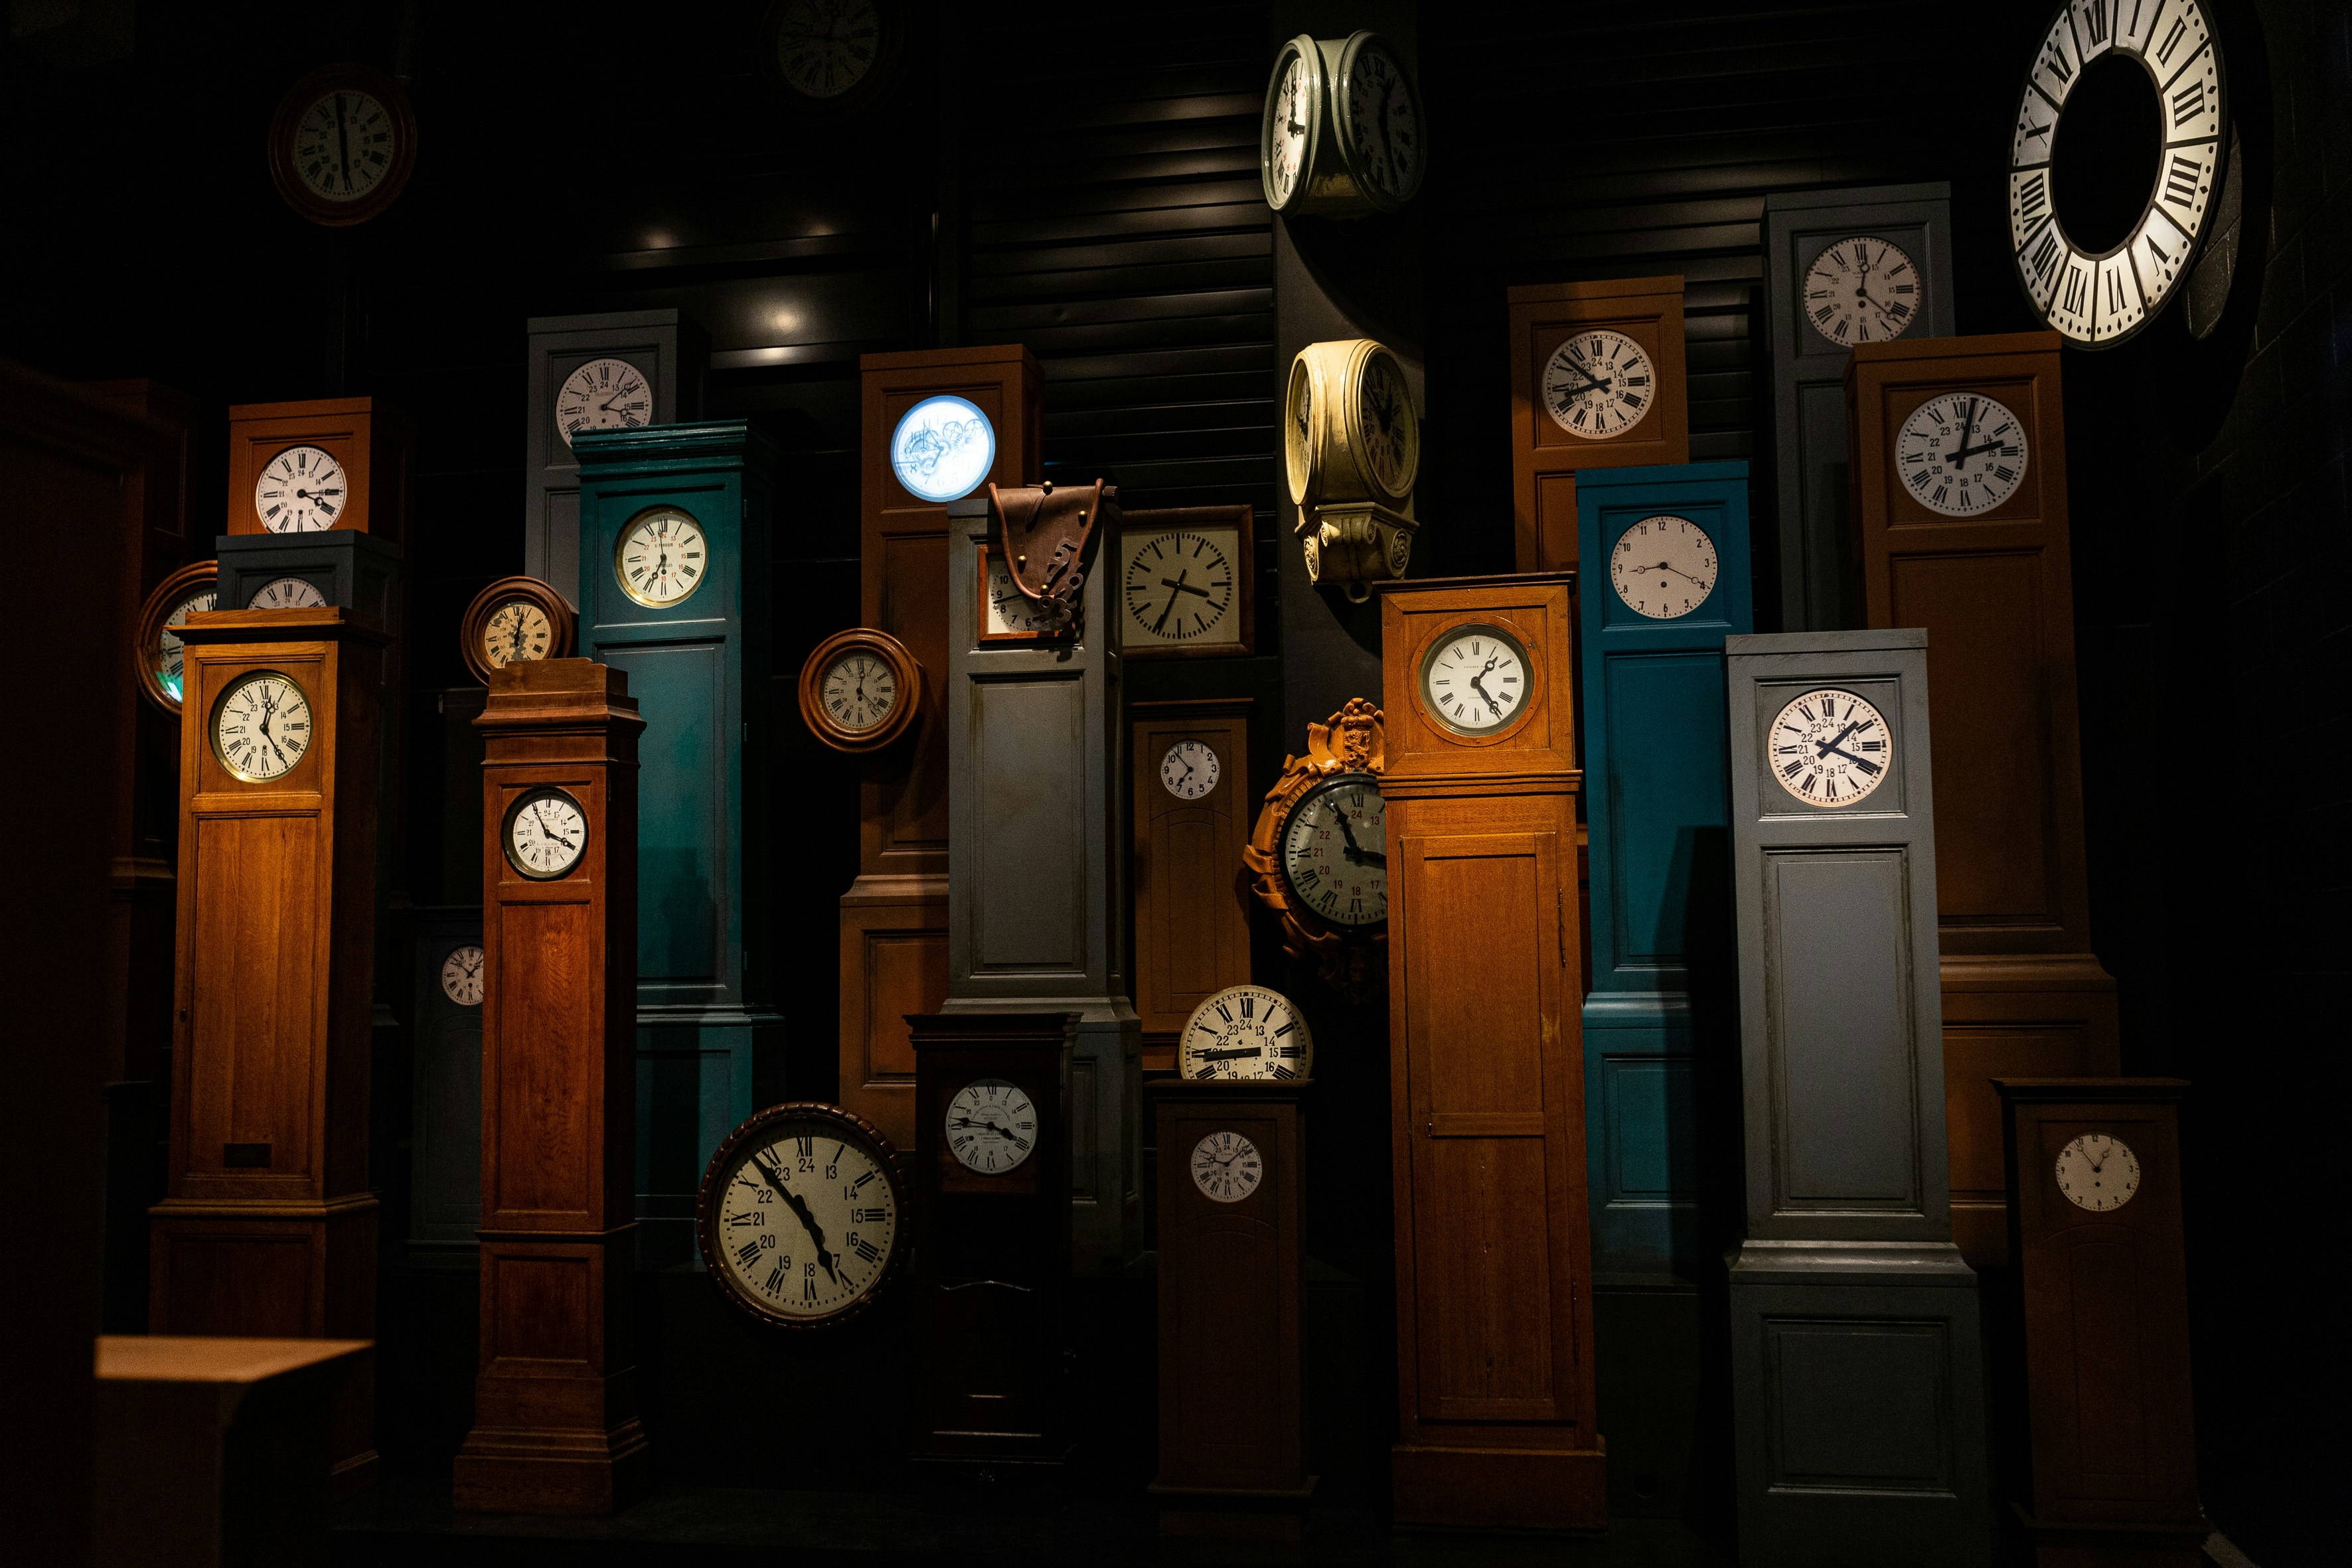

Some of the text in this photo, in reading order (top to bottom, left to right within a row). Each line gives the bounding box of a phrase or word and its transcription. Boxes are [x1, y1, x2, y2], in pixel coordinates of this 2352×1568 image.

[2083, 0, 2109, 54] XII
[2156, 15, 2187, 68] II
[2046, 42, 2073, 96] XI
[2172, 78, 2205, 129] III
[2025, 116, 2052, 148] X
[2164, 154, 2202, 210] IIII
[2031, 228, 2063, 292] VIII
[2146, 234, 2170, 277] V
[2063, 265, 2088, 318] VII
[2106, 266, 2127, 315] VI
[1591, 340, 1603, 357] XII
[1592, 357, 1603, 366] 24
[1605, 361, 1613, 370] 13
[1628, 376, 1645, 386] III
[1606, 399, 1614, 408] 17
[1622, 392, 1642, 409] IIII
[1596, 403, 1603, 412] 18
[1953, 402, 1966, 419] XII
[1940, 427, 1950, 435] 23
[1930, 438, 1940, 447] 22
[2001, 446, 2018, 457] III
[1932, 465, 1942, 475] 20
[1986, 463, 1994, 471] 16
[1912, 469, 1932, 490] VIII
[1944, 475, 1952, 484] 19
[1994, 465, 2015, 483] IIII
[1960, 478, 1968, 487] 18
[1640, 526, 1646, 534] 11
[1658, 522, 1666, 530] 12
[1682, 524, 1684, 532] 1
[1623, 543, 1630, 552] 10
[1697, 539, 1702, 548] 2
[1705, 558, 1709, 567] 3
[1618, 564, 1622, 574] 9
[1000, 576, 1008, 584] 10
[1639, 601, 1644, 610] 7
[1664, 603, 1668, 612] 6
[1684, 599, 1689, 608] 5
[1822, 699, 1834, 717] XII
[1798, 704, 1816, 724] XI
[1811, 724, 1822, 732] 23
[1822, 718, 1834, 728] 24
[1802, 734, 1813, 742] 22
[1778, 745, 1797, 754] IX
[1798, 745, 1808, 753] 21
[1862, 741, 1881, 751] III
[1804, 756, 1815, 765] 20
[1784, 759, 1804, 779] VIII
[1814, 765, 1823, 774] 19
[1827, 768, 1834, 777] 18
[1838, 765, 1847, 773] 17
[1801, 773, 1818, 793] VII
[1826, 779, 1838, 797] VI
[1314, 848, 1322, 857] 21
[1320, 866, 1330, 874] 20
[1334, 880, 1342, 889] 19
[1370, 880, 1379, 889] 17
[1352, 887, 1360, 896] 18
[1240, 998, 1253, 1018] XII
[1215, 1003, 1233, 1025] XI
[1227, 1025, 1239, 1035] 23
[1240, 1020, 1252, 1030] 24
[1255, 1026, 1265, 1036] 13
[1216, 1036, 1229, 1046] 22
[1265, 1037, 1275, 1046] 14
[1269, 1048, 1278, 1057] 15
[1281, 1047, 1300, 1058] III
[1217, 1061, 1229, 1071] 20
[1265, 1062, 1274, 1071] 16
[797, 1136, 812, 1156] XII
[833, 1144, 845, 1164] I
[799, 1158, 815, 1172] 24
[775, 1168, 790, 1181] 23
[826, 1165, 837, 1179] 13
[738, 1175, 759, 1192] X
[854, 1170, 875, 1188] II
[757, 1190, 773, 1204] 22
[844, 1186, 858, 1200] 14
[731, 1212, 751, 1226] IX
[753, 1212, 765, 1225] 21
[852, 1209, 863, 1223] 15
[864, 1208, 885, 1221] III
[760, 1235, 775, 1249] 20
[846, 1232, 858, 1246] 16
[738, 1241, 763, 1269] VIII
[854, 1239, 880, 1263] IIII
[779, 1255, 791, 1269] 19
[805, 1263, 815, 1277] 18
[765, 1268, 785, 1294] VII
[838, 1269, 854, 1290] V
[804, 1278, 817, 1300] VI
